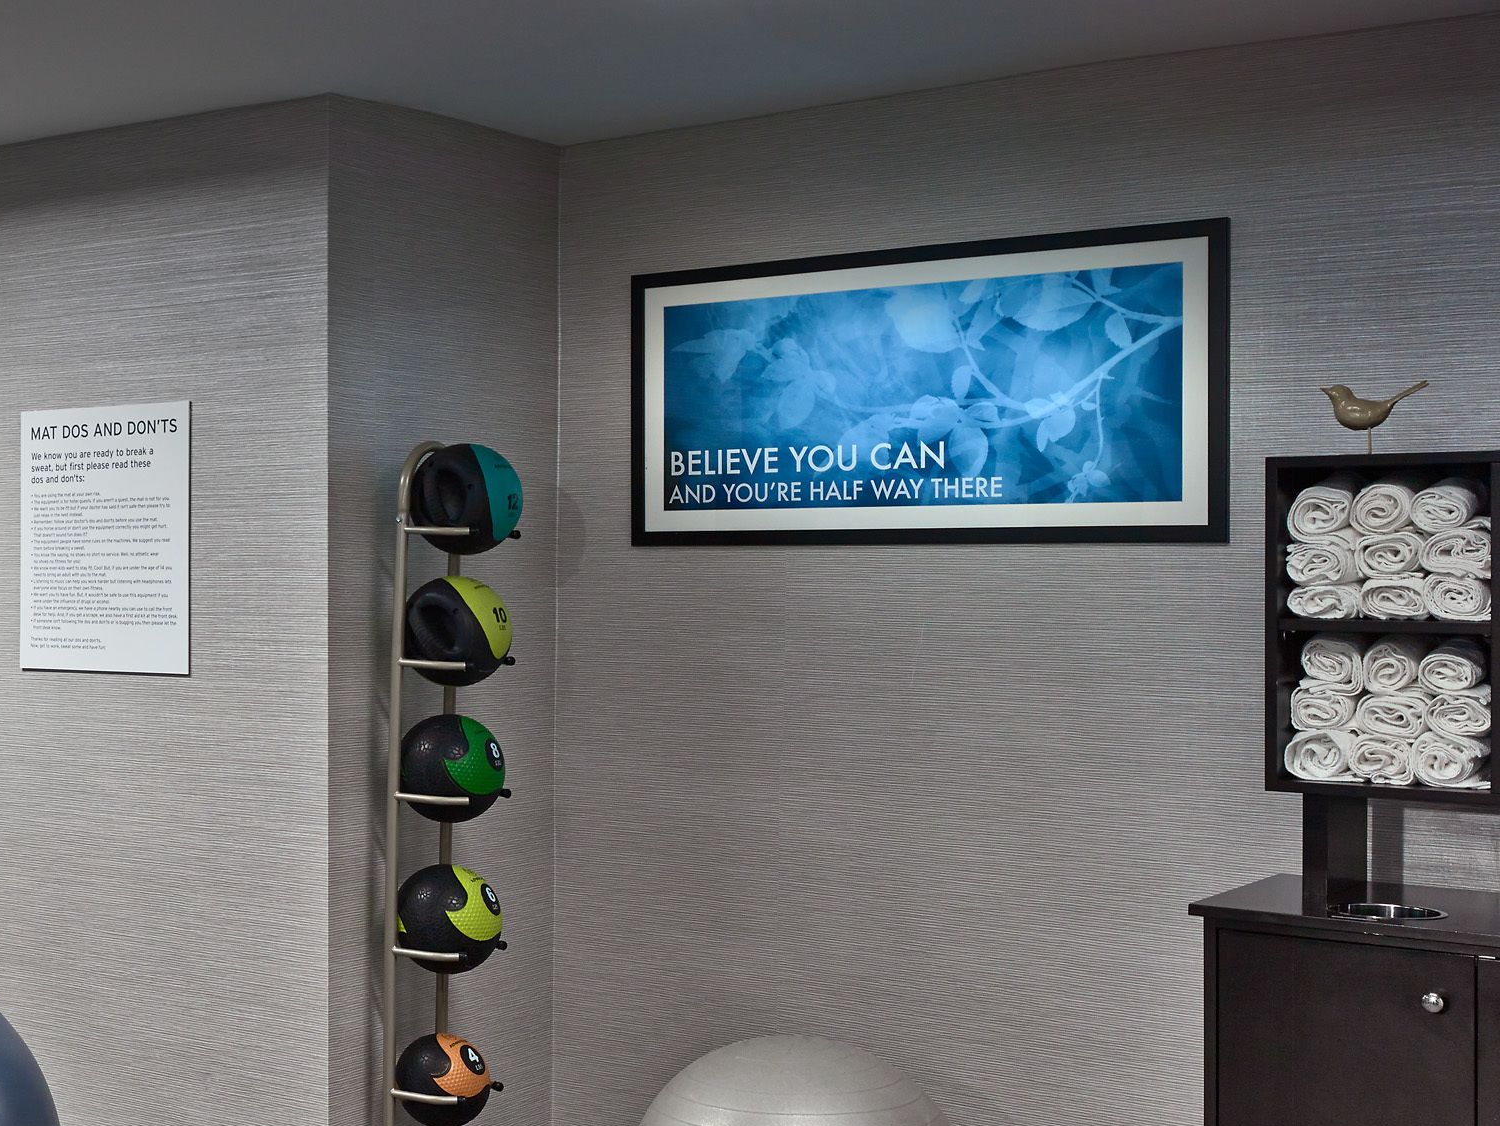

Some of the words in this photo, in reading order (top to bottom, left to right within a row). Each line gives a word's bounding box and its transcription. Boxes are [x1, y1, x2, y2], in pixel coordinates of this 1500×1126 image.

[31, 426, 57, 440] MAT
[62, 424, 89, 439] DOS
[94, 422, 122, 437] AND
[127, 418, 178, 435] DON'TS
[43, 452, 63, 460] know
[64, 452, 78, 460] you
[93, 450, 114, 459] ready
[116, 449, 124, 457] to
[126, 447, 147, 456] break
[670, 447, 779, 476] BELIEVE
[789, 444, 857, 472] YOU
[870, 440, 946, 470] CAN
[31, 464, 53, 472] sweat,
[55, 463, 68, 471] but
[69, 462, 84, 471] first
[86, 461, 110, 471] please
[111, 460, 128, 469] read
[130, 459, 151, 468] these
[31, 476, 43, 484] dos
[45, 475, 59, 483] and
[60, 474, 85, 483] don'ts:
[669, 484, 715, 504] AND
[722, 481, 802, 502] YOU'RE
[810, 480, 863, 501] HALF
[870, 478, 924, 500] WAY
[930, 476, 1003, 498] THERE
[507, 494, 519, 510] 12
[492, 607, 507, 623] 10
[490, 742, 500, 758] 8
[485, 887, 496, 902] 6
[467, 1047, 479, 1063] 4
